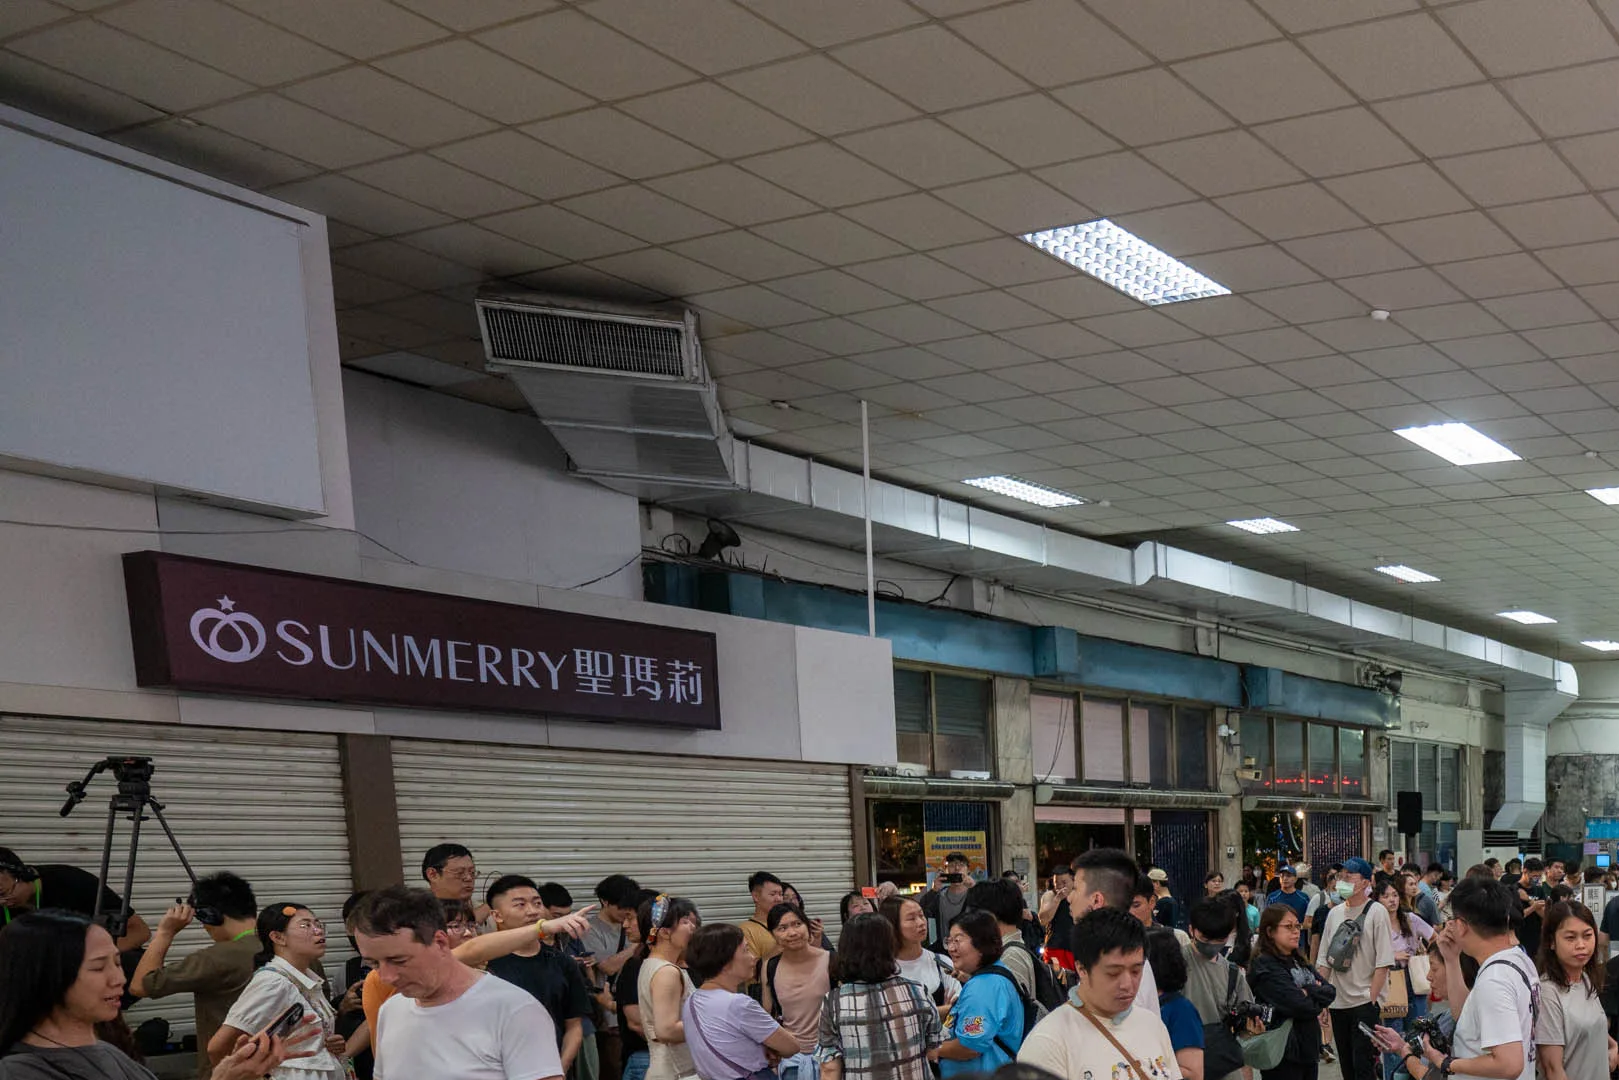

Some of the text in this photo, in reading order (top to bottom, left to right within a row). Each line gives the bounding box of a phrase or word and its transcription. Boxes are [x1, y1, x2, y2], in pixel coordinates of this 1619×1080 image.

[276, 618, 704, 706] SUNMERRY 聖瑪莉
